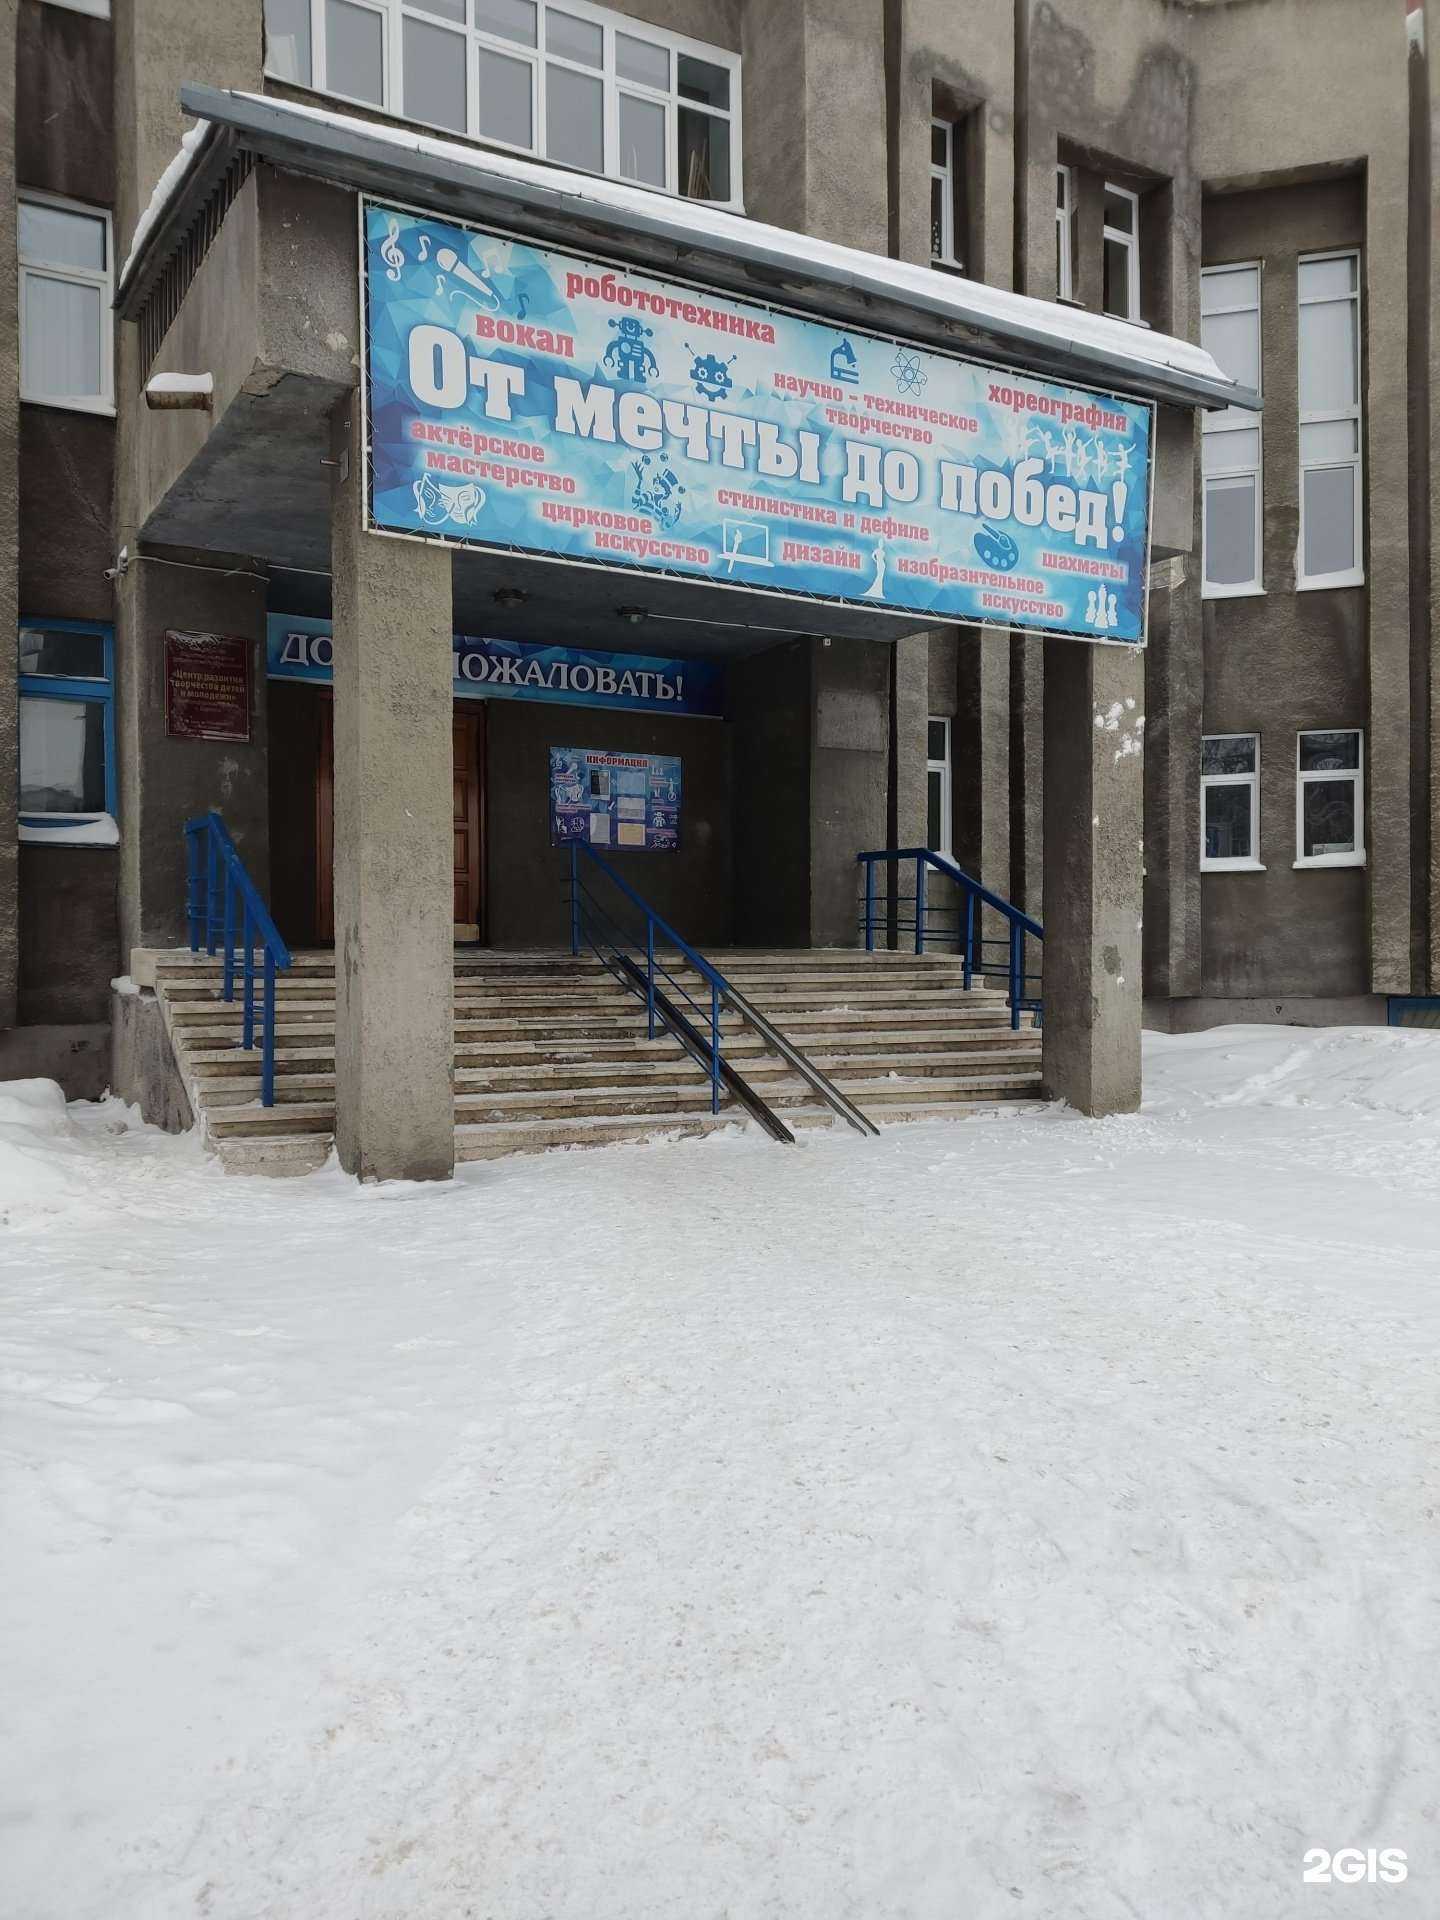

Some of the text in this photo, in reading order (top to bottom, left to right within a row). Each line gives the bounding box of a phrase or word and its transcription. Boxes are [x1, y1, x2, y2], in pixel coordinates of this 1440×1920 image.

[566, 271, 775, 344] робототехника
[475, 313, 575, 358] вокал
[774, 373, 843, 402] научно
[863, 394, 978, 433] техническое
[988, 384, 1127, 432] хореография
[408, 324, 1128, 550] От мечты до побед!
[411, 421, 545, 463] актёрское
[825, 407, 933, 444] творчество
[426, 451, 576, 494] мастерство
[541, 501, 652, 535] цирковое
[717, 487, 930, 542] стилистика и дефиле
[594, 530, 710, 565] искусство
[782, 541, 861, 570] дизайн
[1042, 551, 1125, 580] шахматы
[897, 556, 1044, 595] изобразительное
[982, 592, 1064, 618] искусство
[586, 755, 649, 768] ИНФОРМАЦИЯ
